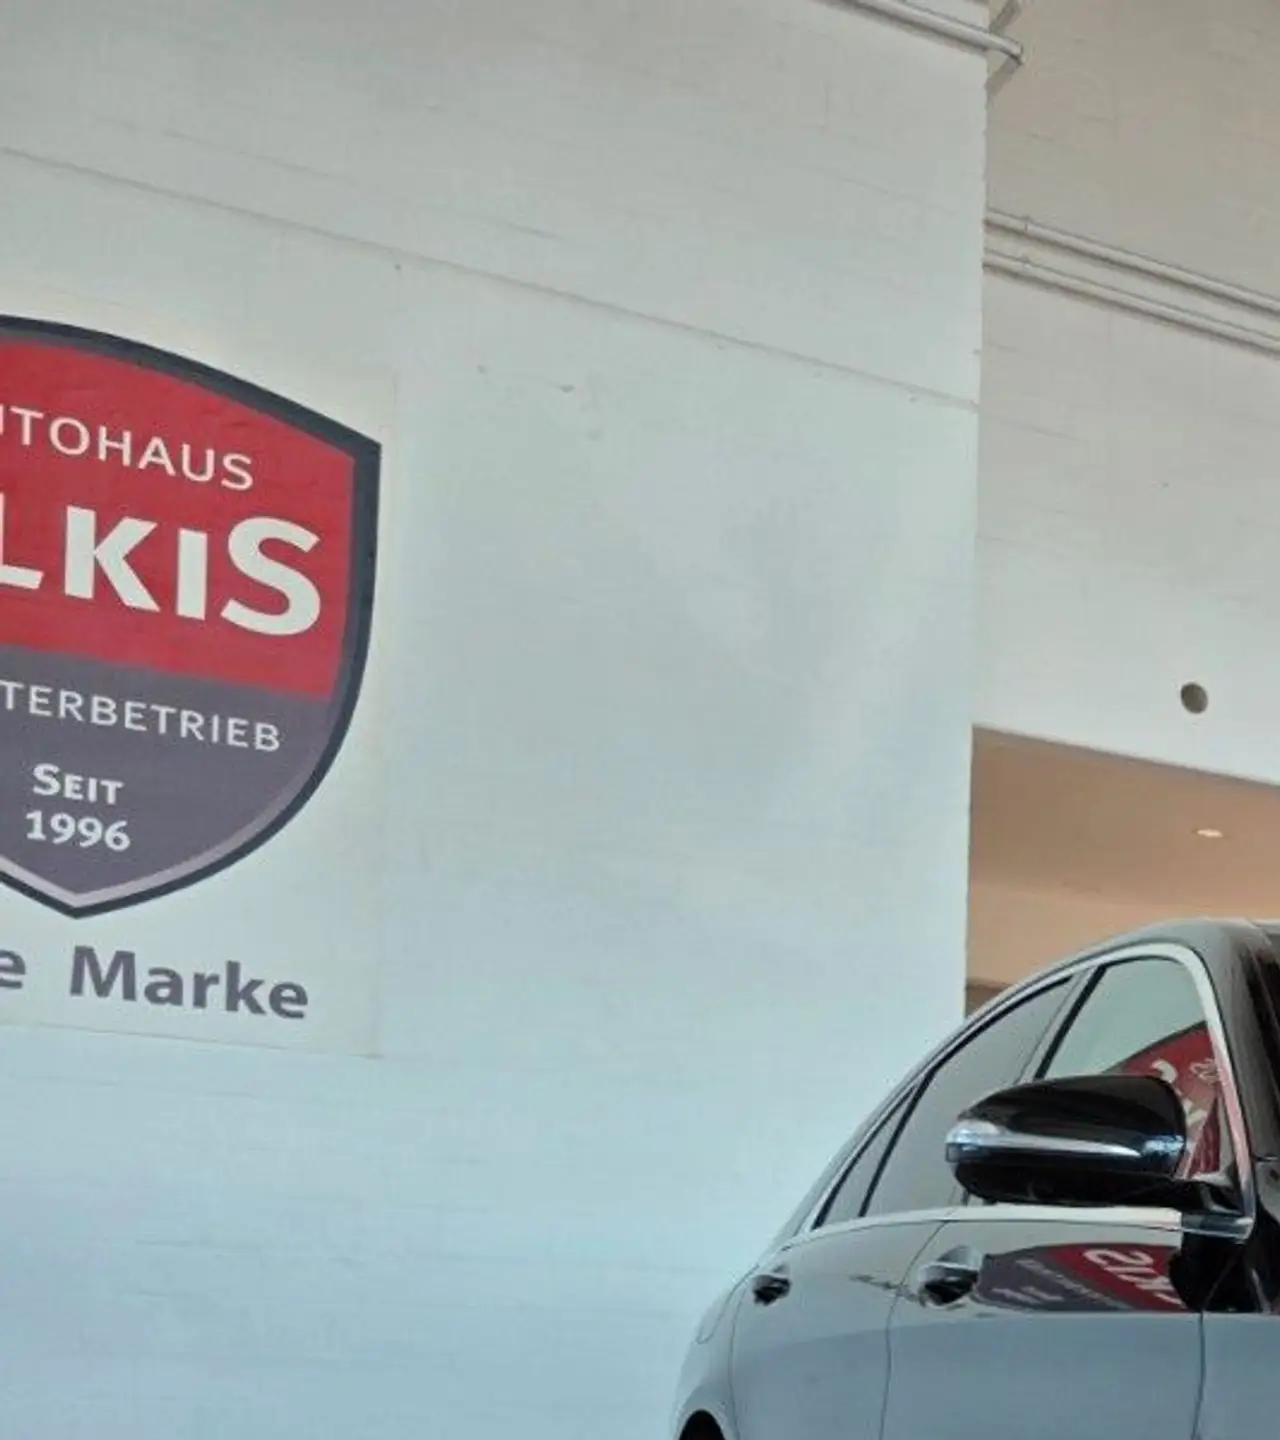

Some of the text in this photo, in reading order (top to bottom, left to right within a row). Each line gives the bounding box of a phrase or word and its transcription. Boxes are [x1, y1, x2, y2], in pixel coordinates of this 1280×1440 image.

[0, 403, 254, 491] TOHAUS
[0, 679, 282, 752] TERBETRIEB
[25, 810, 132, 852] 1996
[69, 945, 309, 1020] Marke
